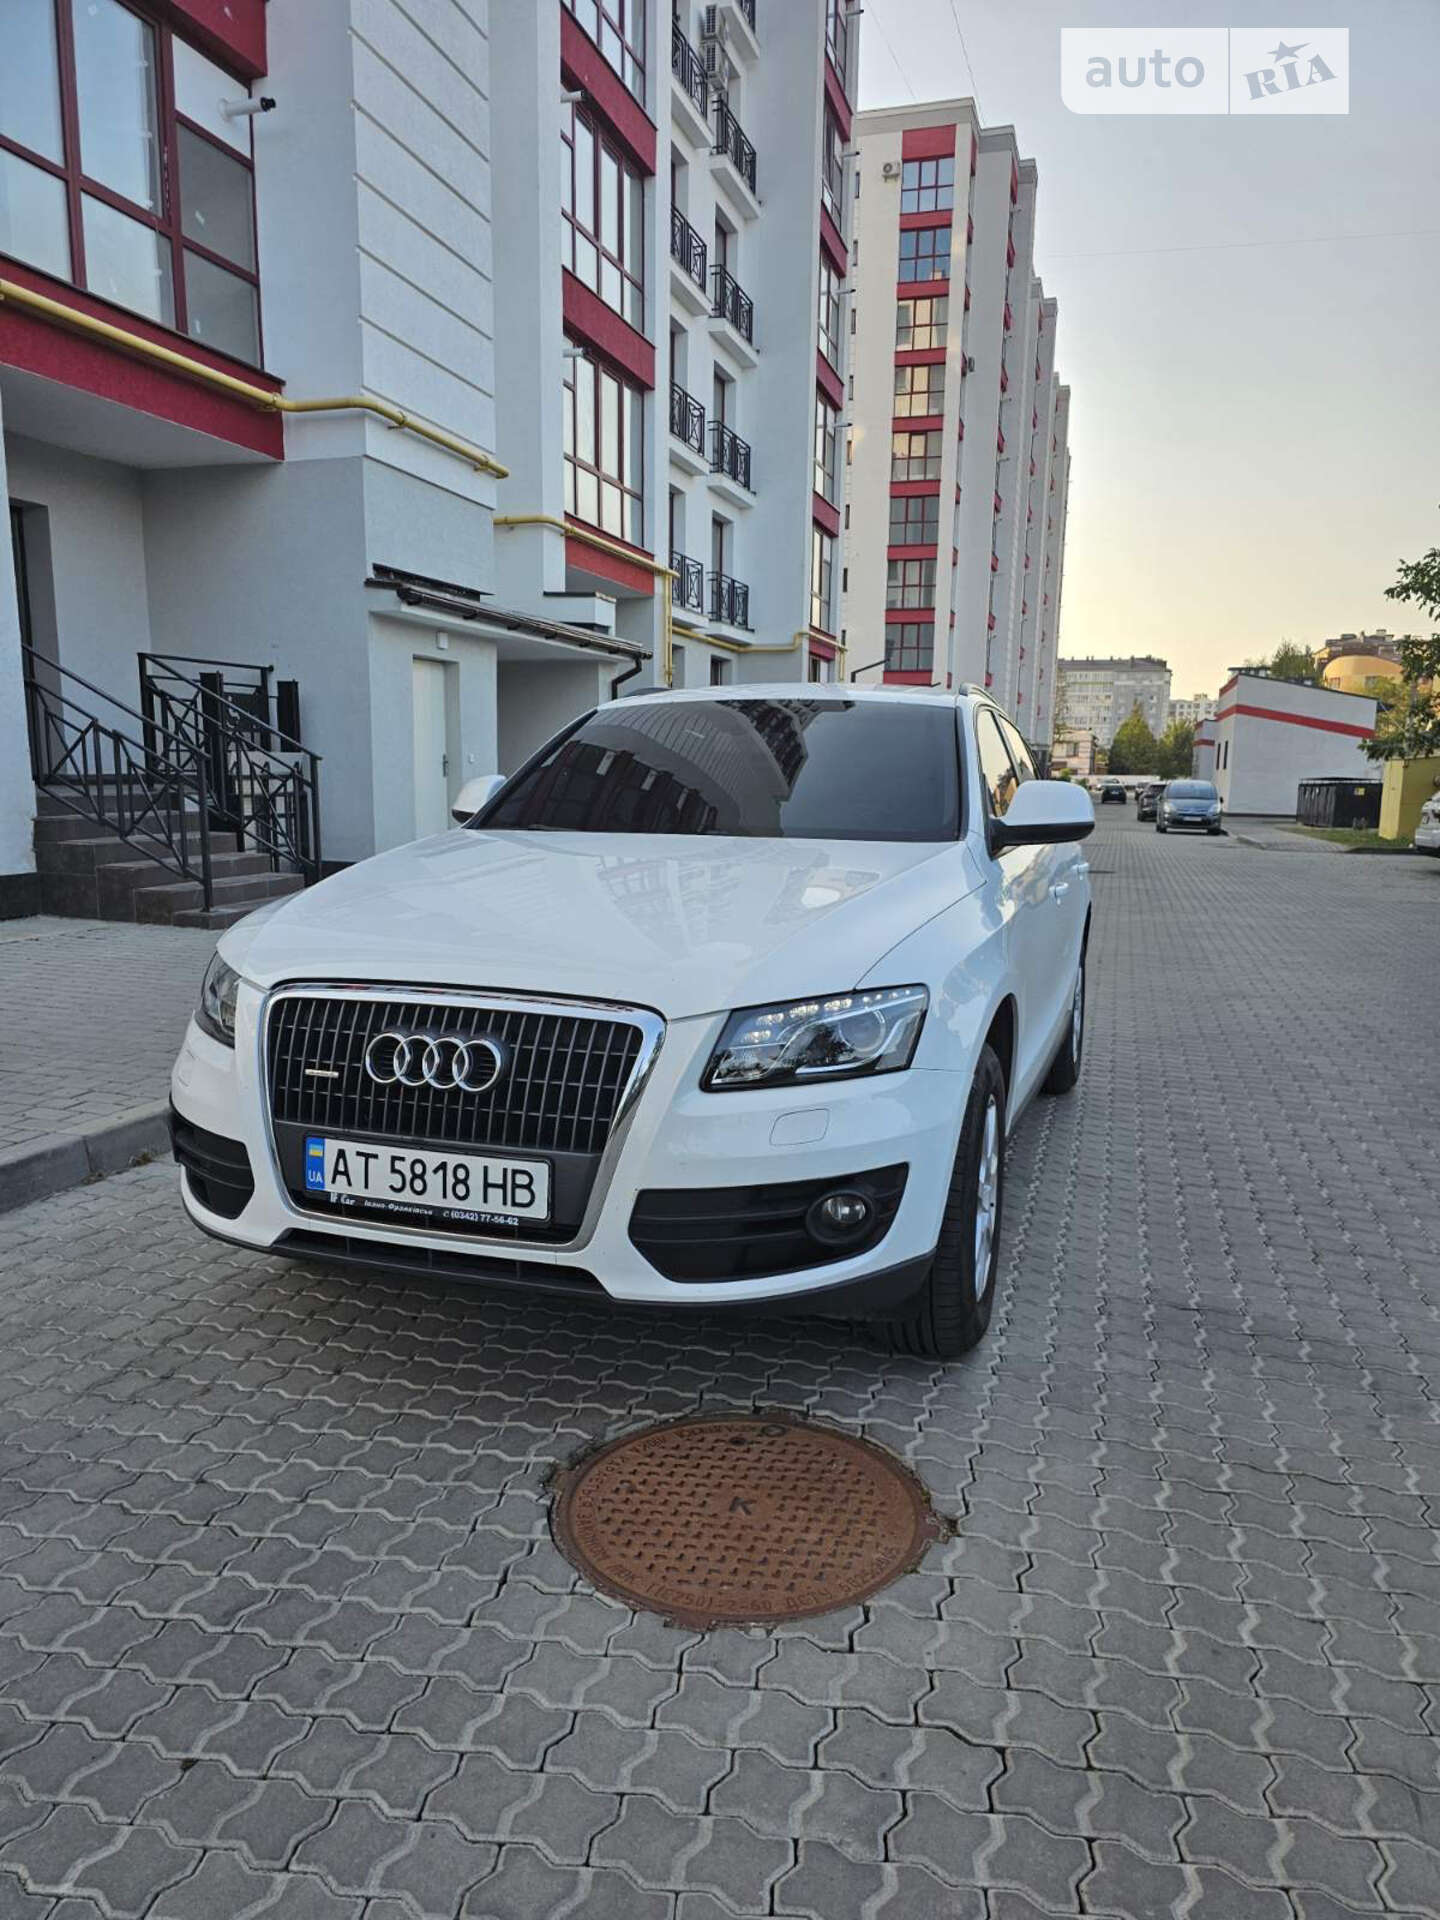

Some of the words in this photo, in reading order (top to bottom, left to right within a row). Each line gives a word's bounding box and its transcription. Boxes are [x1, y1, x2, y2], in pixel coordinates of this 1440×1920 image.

[308, 1170, 324, 1184] UA
[331, 1148, 379, 1190] AT
[388, 1155, 470, 1201] 5818
[483, 1165, 536, 1208] HB
[451, 1210, 479, 1222] (0342)
